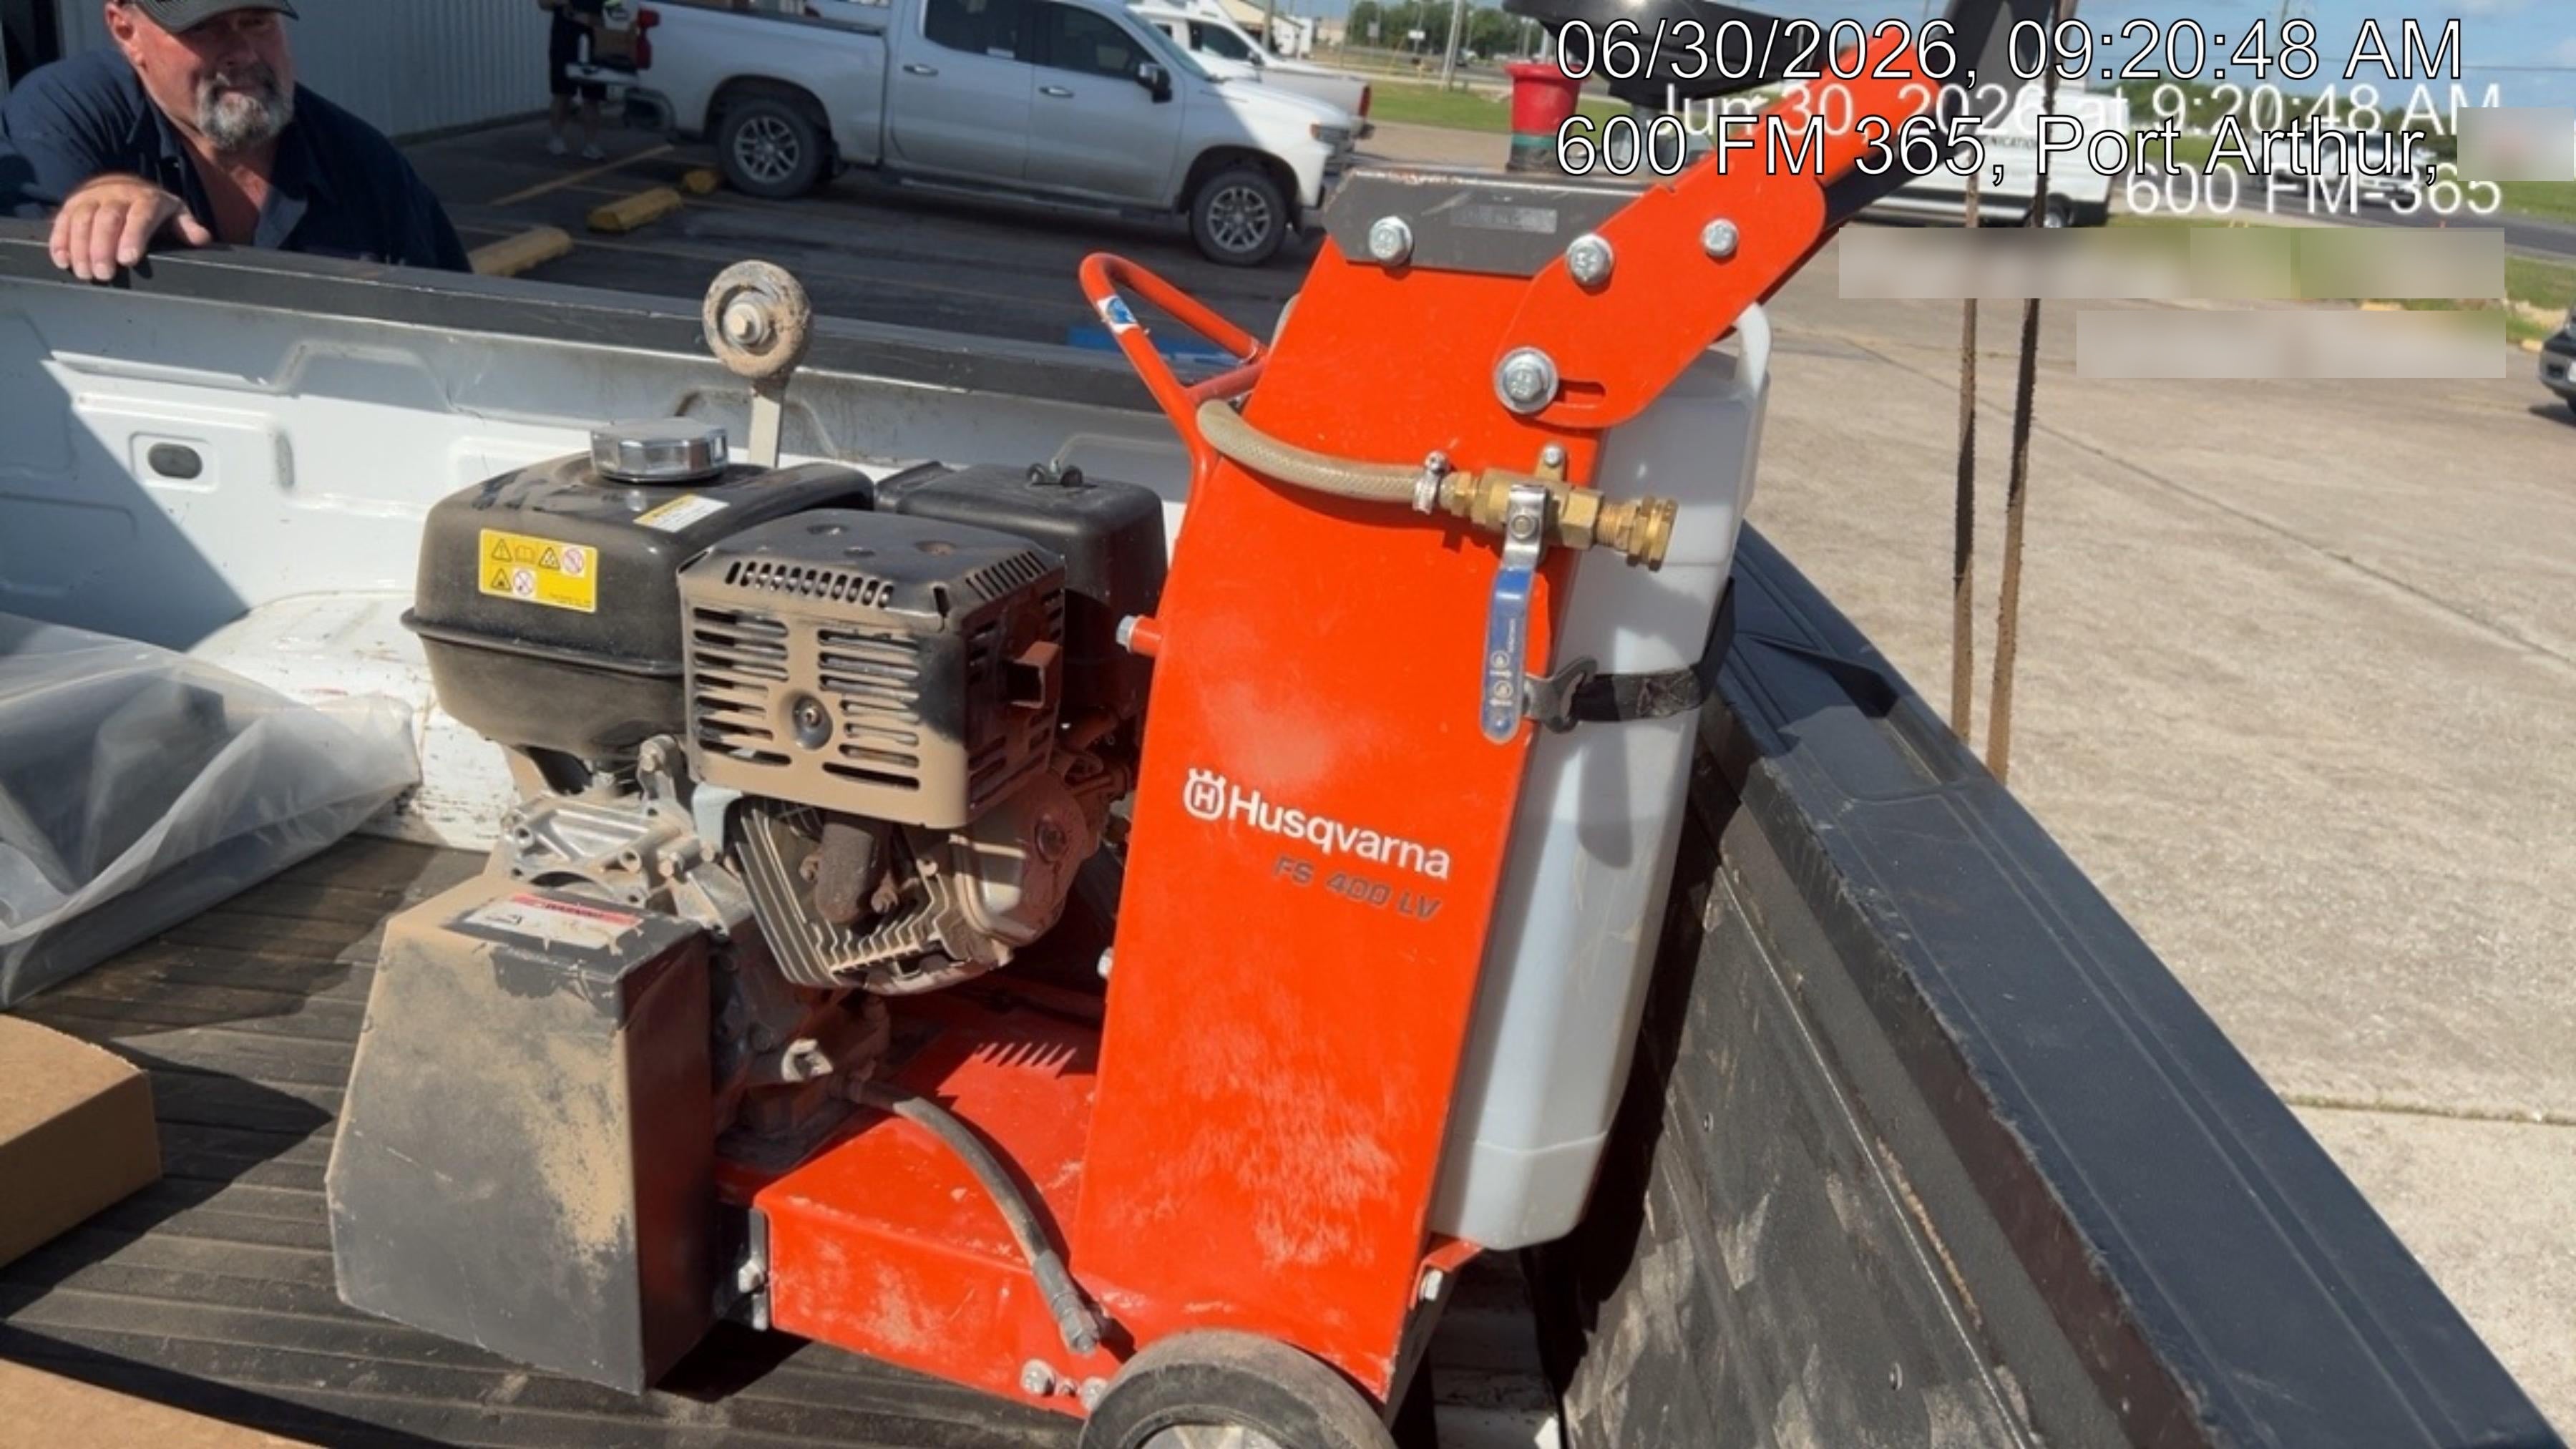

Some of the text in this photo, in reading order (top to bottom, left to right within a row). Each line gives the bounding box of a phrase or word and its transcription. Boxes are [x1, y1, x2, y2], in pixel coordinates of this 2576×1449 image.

[1228, 784, 1451, 881] Husqvarna
[1274, 855, 1442, 919] FS 400 LV
